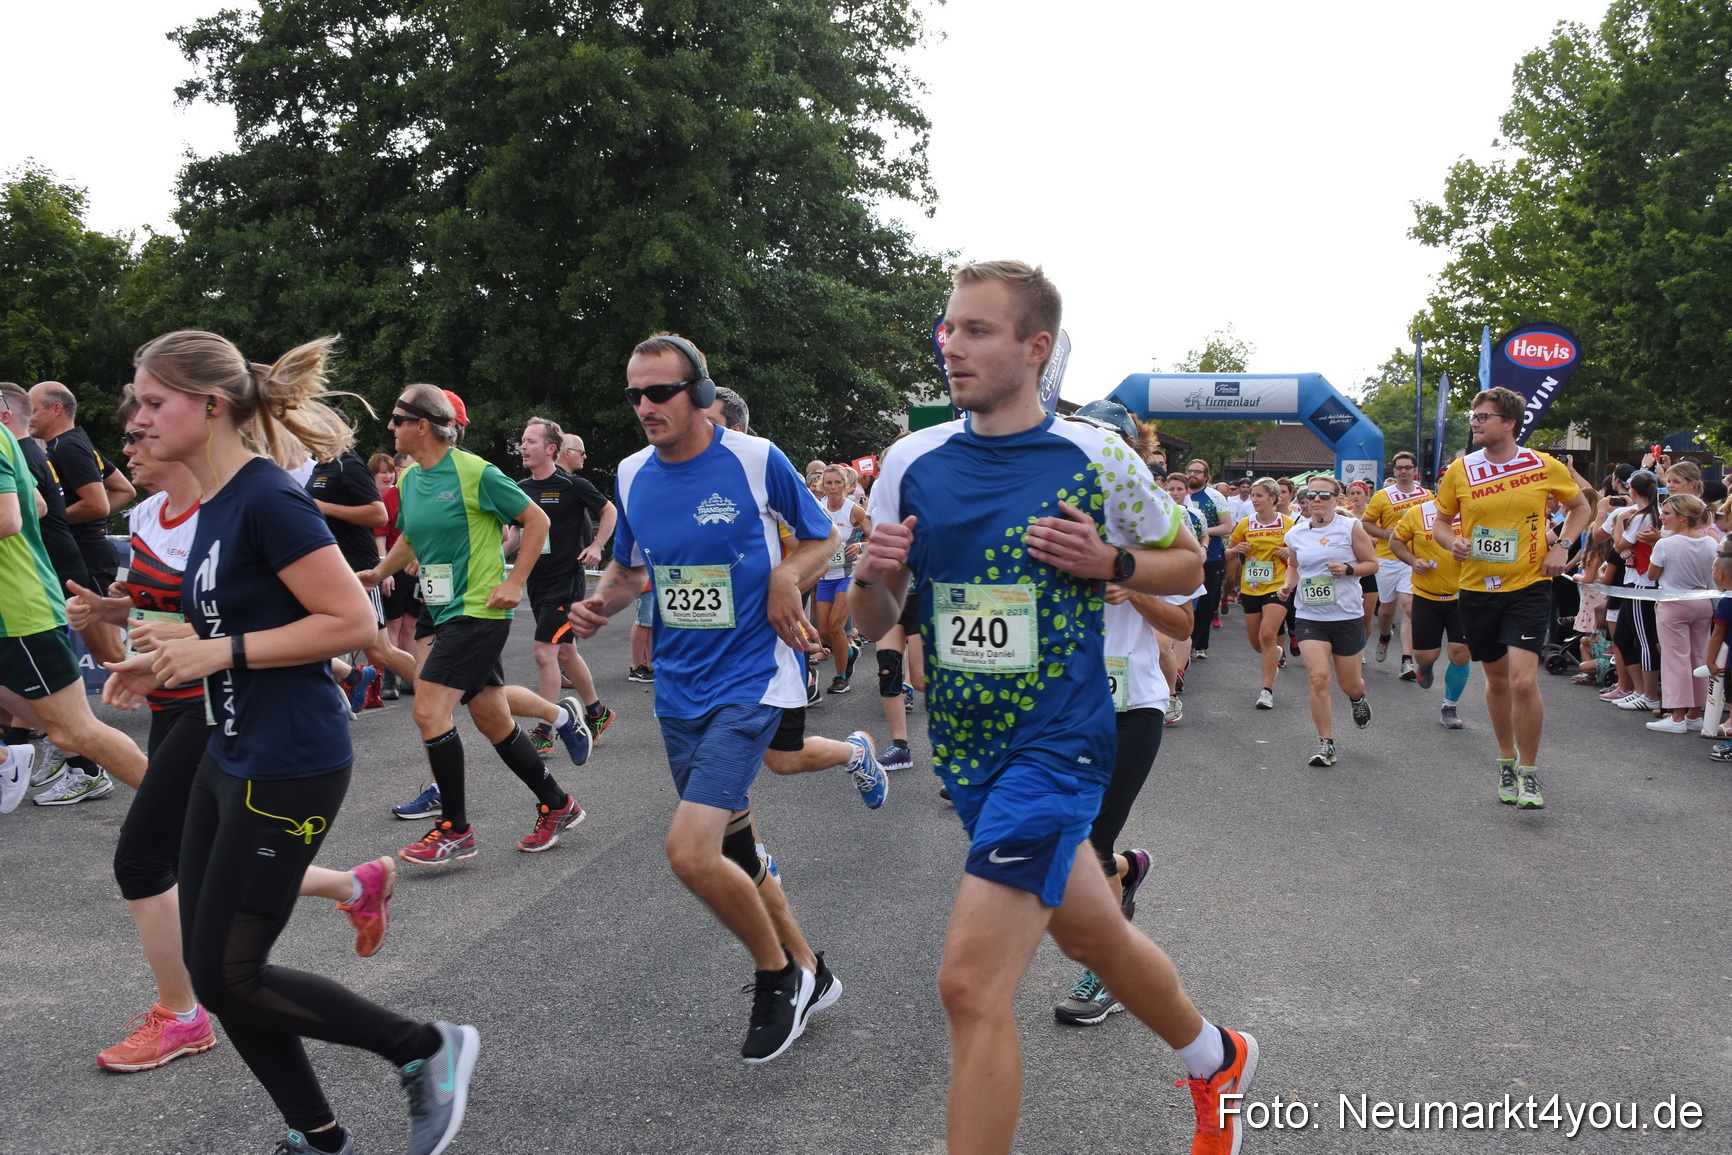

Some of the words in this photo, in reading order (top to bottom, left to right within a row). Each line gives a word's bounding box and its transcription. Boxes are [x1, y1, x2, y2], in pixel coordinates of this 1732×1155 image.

[1512, 339, 1570, 362] Hervis
[1205, 396, 1261, 407] firmenlauf
[1515, 375, 1559, 442] OVIN
[1471, 482, 1506, 500] MAX
[1509, 471, 1548, 489] BÖGL
[1392, 502, 1412, 513] MAX
[1476, 538, 1510, 554] 1681
[1248, 568, 1270, 578] 1670
[1304, 586, 1331, 598] 1366
[665, 588, 722, 611] 2323
[1007, 608, 1029, 616] 2019
[951, 615, 1009, 649] 240
[949, 647, 985, 659] Michalsky
[986, 649, 1015, 658] Daniel
